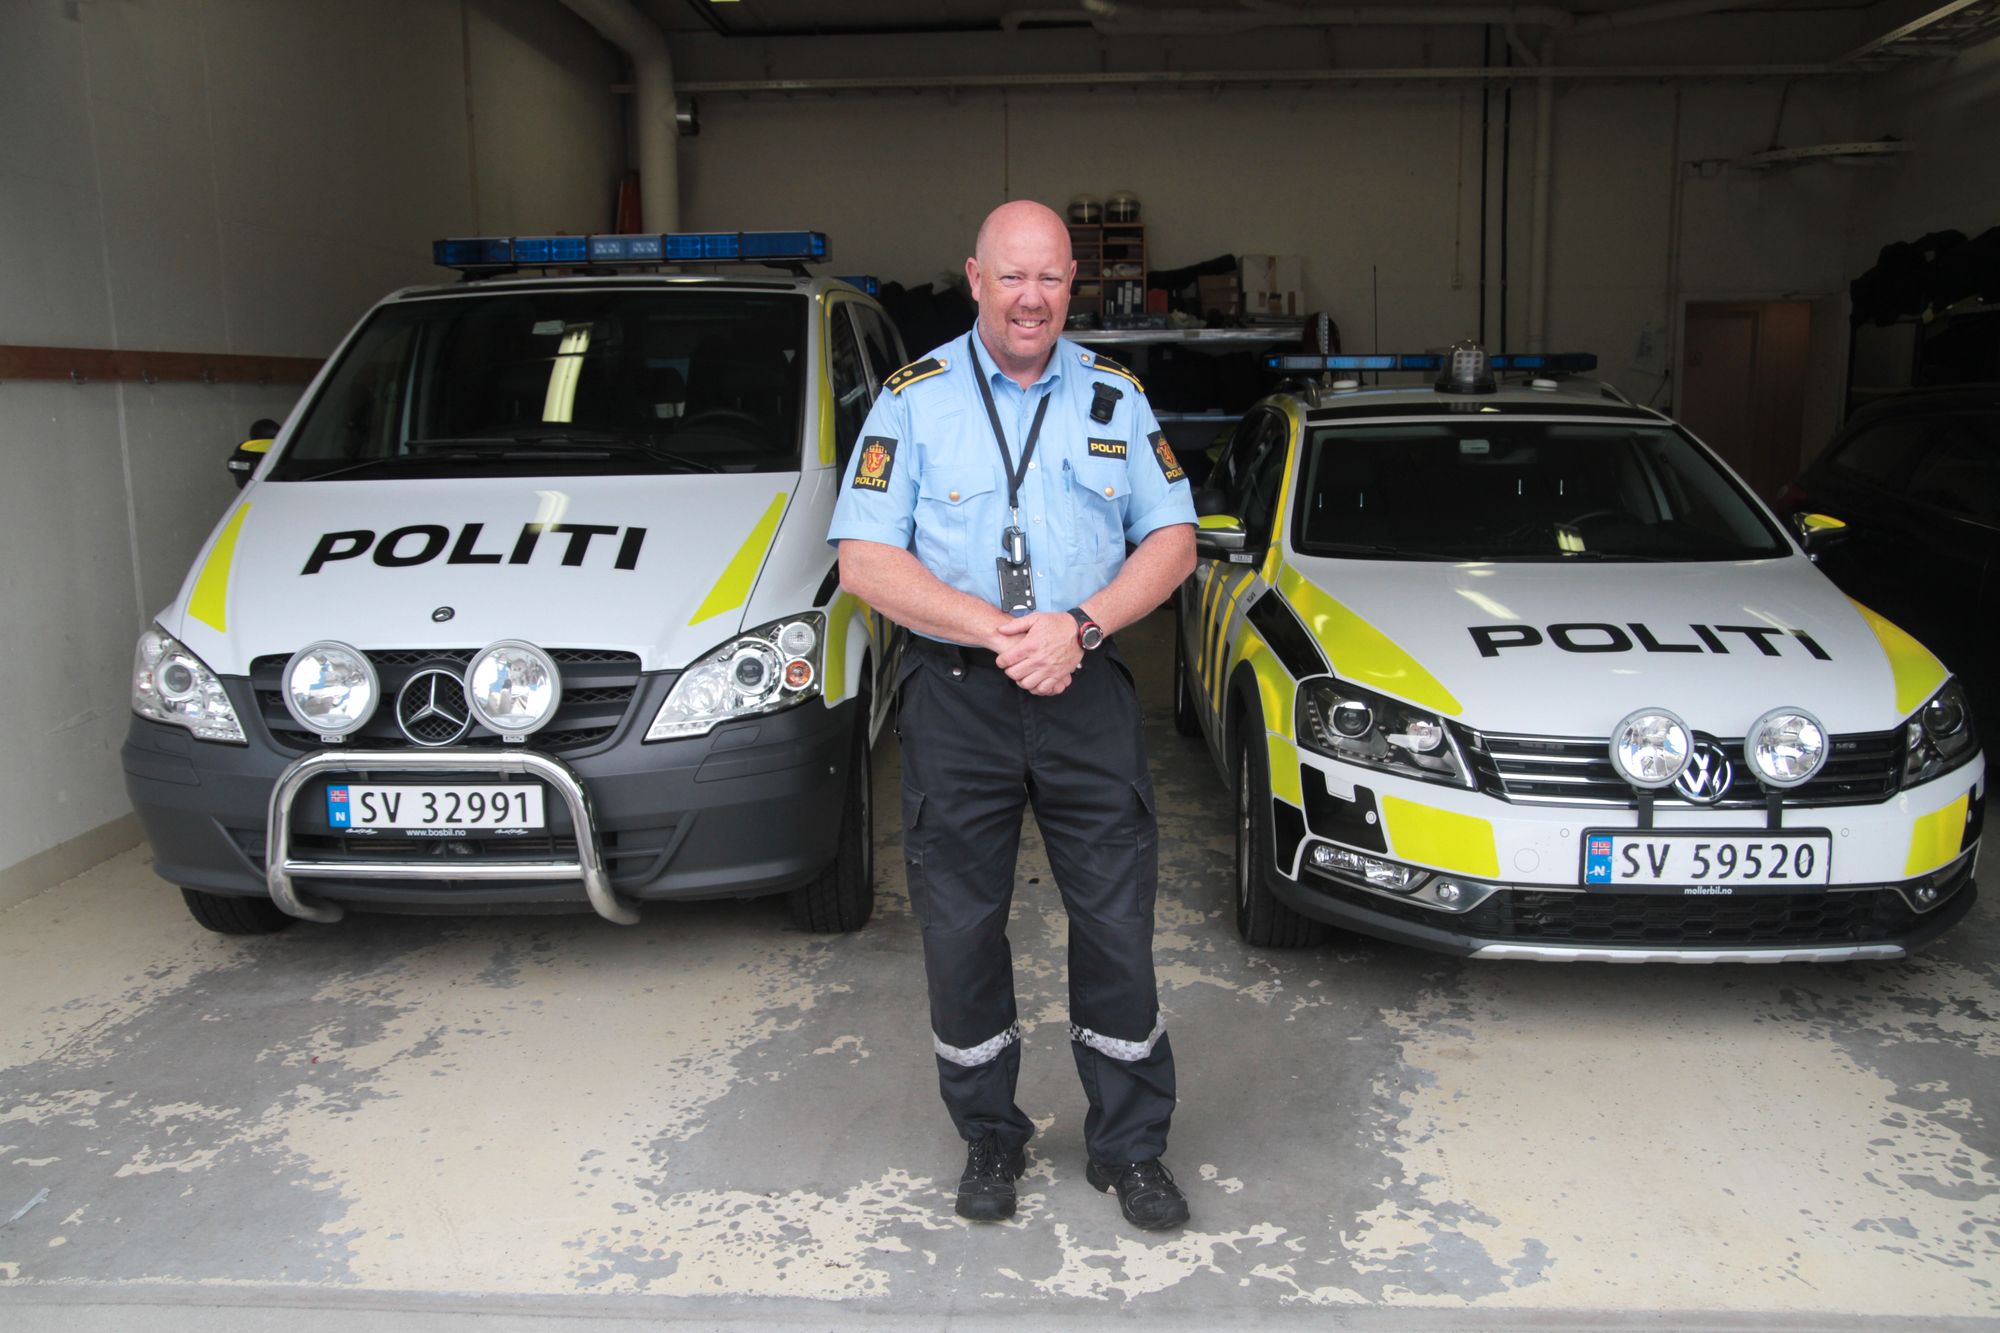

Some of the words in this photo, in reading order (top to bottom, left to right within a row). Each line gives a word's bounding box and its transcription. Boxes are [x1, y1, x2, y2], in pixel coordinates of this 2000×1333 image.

[1090, 442, 1126, 454] POLITI
[855, 477, 887, 488] POLITI
[300, 523, 647, 575] POLITI
[1467, 623, 1832, 661] POLITI
[361, 792, 402, 822] SV
[421, 792, 528, 823] 32991
[336, 811, 346, 821] N
[406, 828, 466, 837] www.bosbil.no
[1621, 843, 1670, 878] SV
[1690, 843, 1815, 878] 59520
[1594, 865, 1605, 876] N
